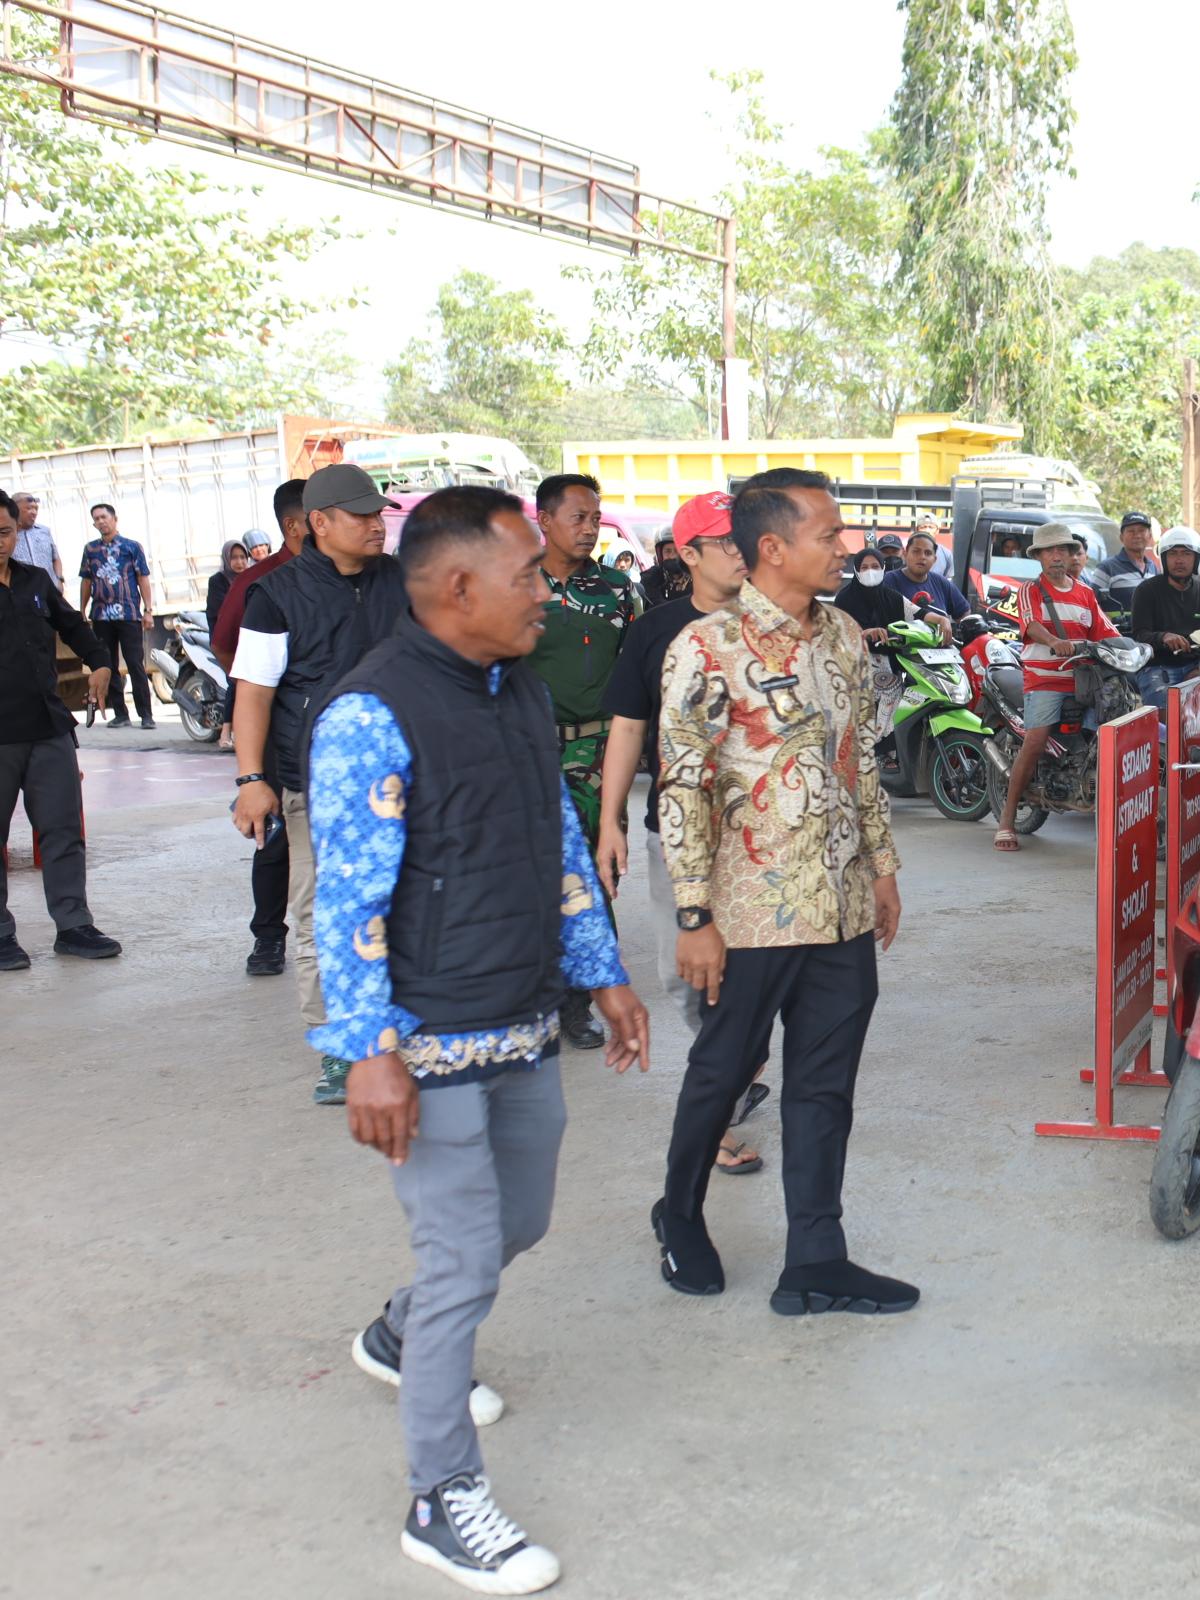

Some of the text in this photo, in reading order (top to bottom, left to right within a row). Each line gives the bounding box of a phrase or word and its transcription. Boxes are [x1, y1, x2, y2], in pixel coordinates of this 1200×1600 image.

[1122, 742, 1151, 784] SEDANG
[1118, 786, 1154, 837] ISTIRAHAT
[1131, 843, 1139, 873] &
[1121, 880, 1149, 930] SHOLAT
